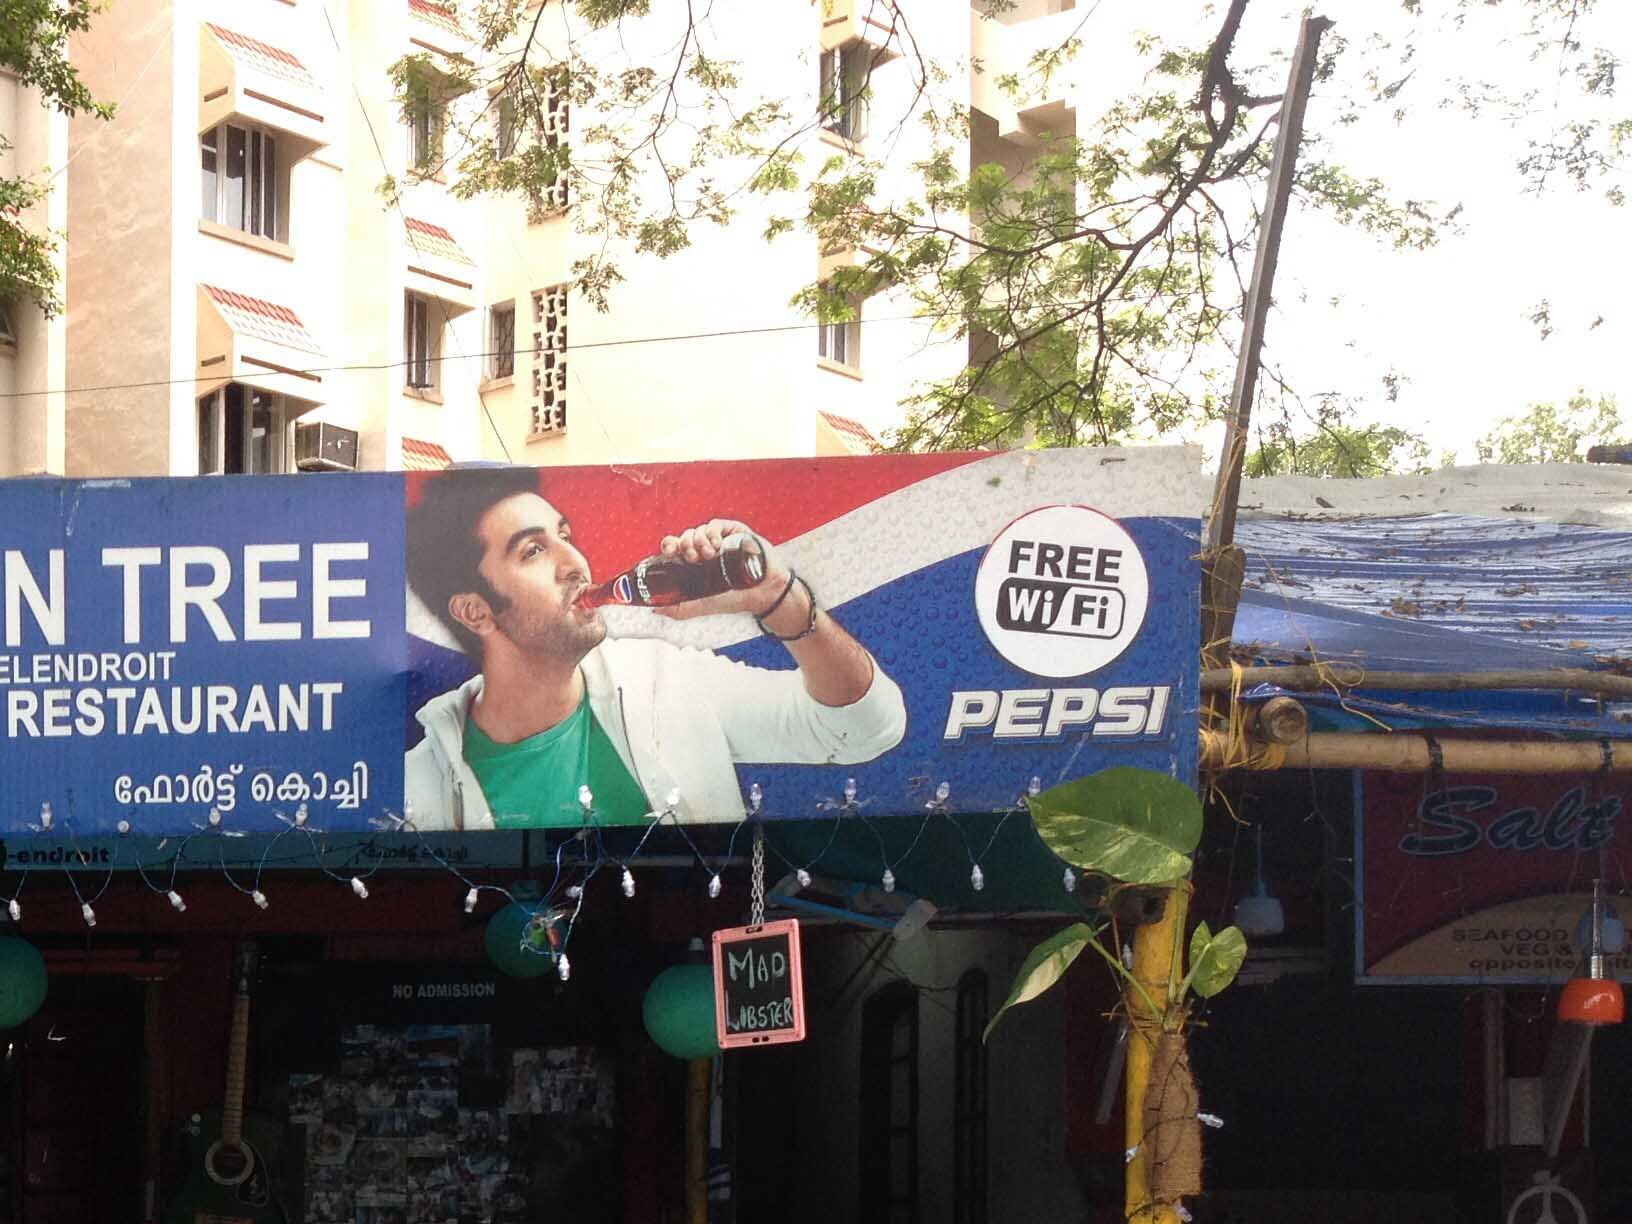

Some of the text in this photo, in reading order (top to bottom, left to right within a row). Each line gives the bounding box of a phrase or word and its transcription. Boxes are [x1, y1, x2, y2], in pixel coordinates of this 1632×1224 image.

[1007, 537, 1123, 583] FREE
[102, 541, 372, 644] TREE
[6, 682, 344, 738] RESTAURANT
[944, 685, 1171, 739] PEPSI
[251, 760, 369, 809] കൊച്ചി
[1453, 928, 1569, 942] SEAFOOD
[1500, 942, 1548, 956] VEG
[392, 982, 496, 999] NO ADMISSION
[728, 947, 786, 990] MAD
